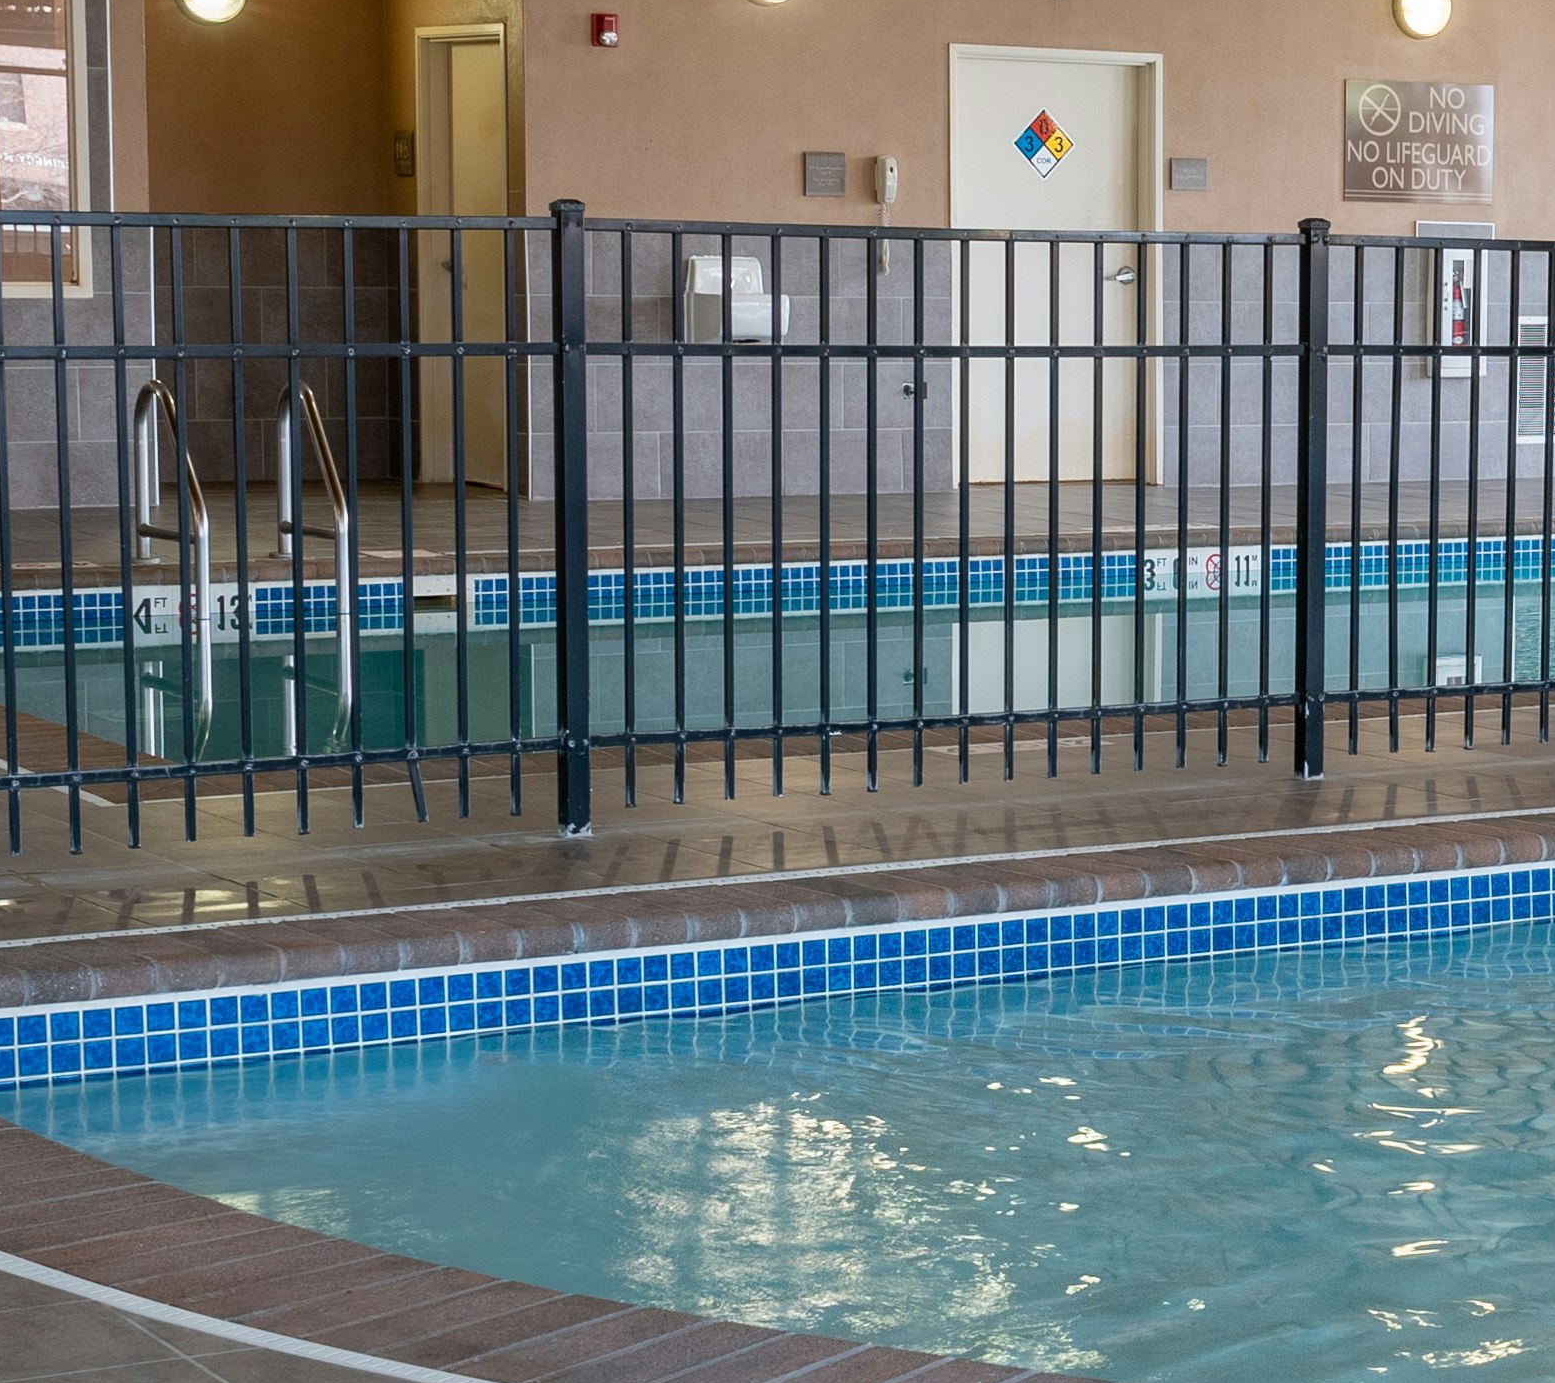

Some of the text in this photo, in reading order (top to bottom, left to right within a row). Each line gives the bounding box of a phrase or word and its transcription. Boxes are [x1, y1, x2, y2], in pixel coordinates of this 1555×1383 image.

[1429, 86, 1465, 110] NO
[1409, 111, 1485, 136] DIVING
[1025, 136, 1034, 152] 3
[1055, 136, 1063, 152] 3
[1347, 140, 1491, 166] NO LIFEGUARD
[1372, 166, 1466, 191] ON DUTY
[1157, 558, 1167, 567] FT
[1189, 557, 1198, 566] IN
[133, 598, 167, 617] 4 FT
